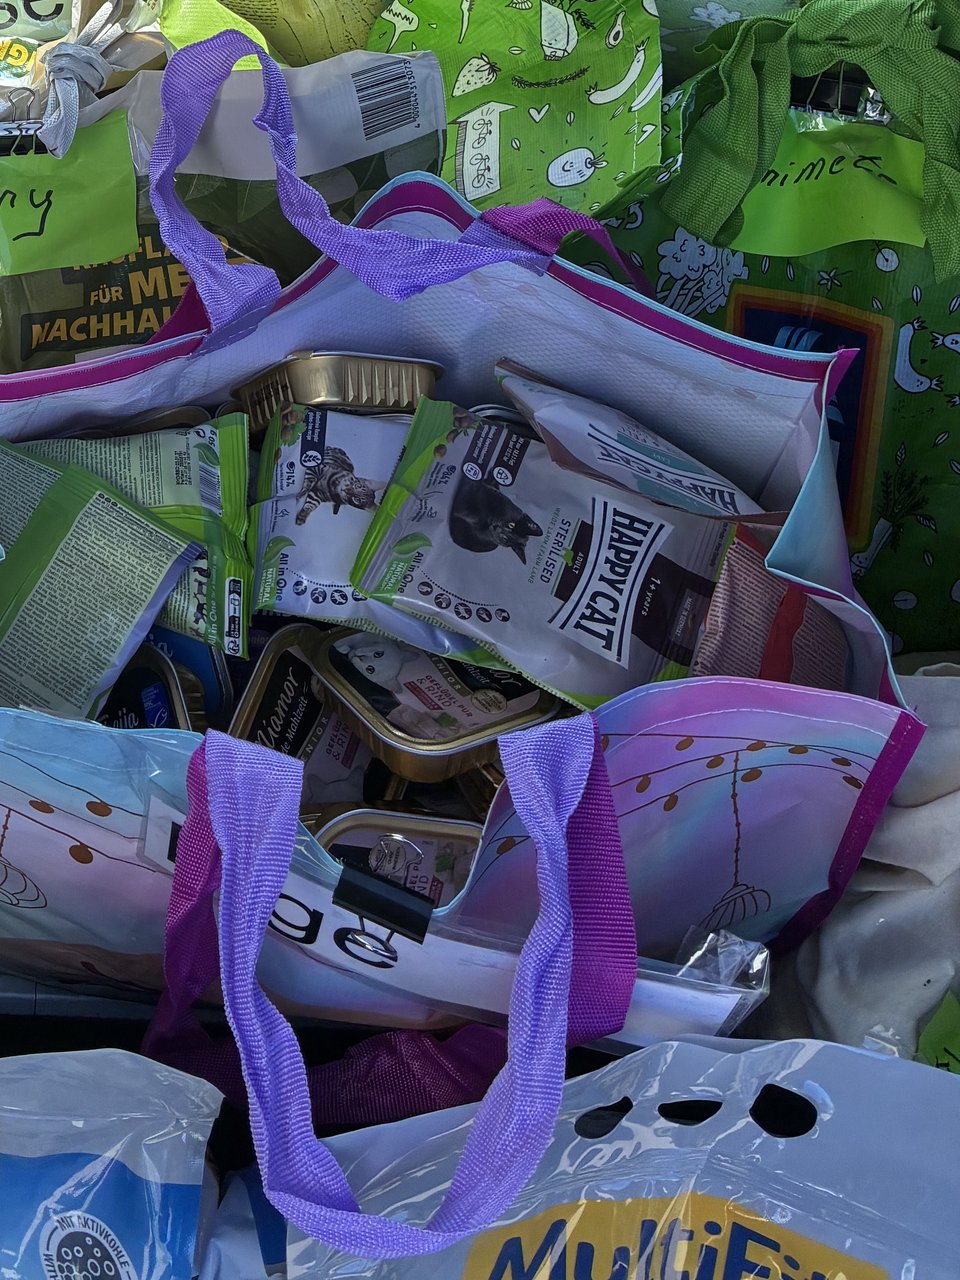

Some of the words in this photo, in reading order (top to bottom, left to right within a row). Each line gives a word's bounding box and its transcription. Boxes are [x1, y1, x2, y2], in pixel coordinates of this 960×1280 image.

[89, 283, 124, 307] FÜR
[279, 552, 290, 567] All
[413, 551, 425, 566] All
[540, 518, 572, 585] STERILISED
[572, 551, 585, 575] ADULT
[598, 506, 654, 597] HAPPY
[275, 578, 287, 602] One
[397, 573, 414, 594] One
[573, 589, 620, 652] CAT
[424, 684, 452, 708] RIND
[285, 696, 309, 743] Mahlzeit
[56, 1215, 75, 1231] MIT
[76, 1215, 130, 1268] AKTIVKOHLE
